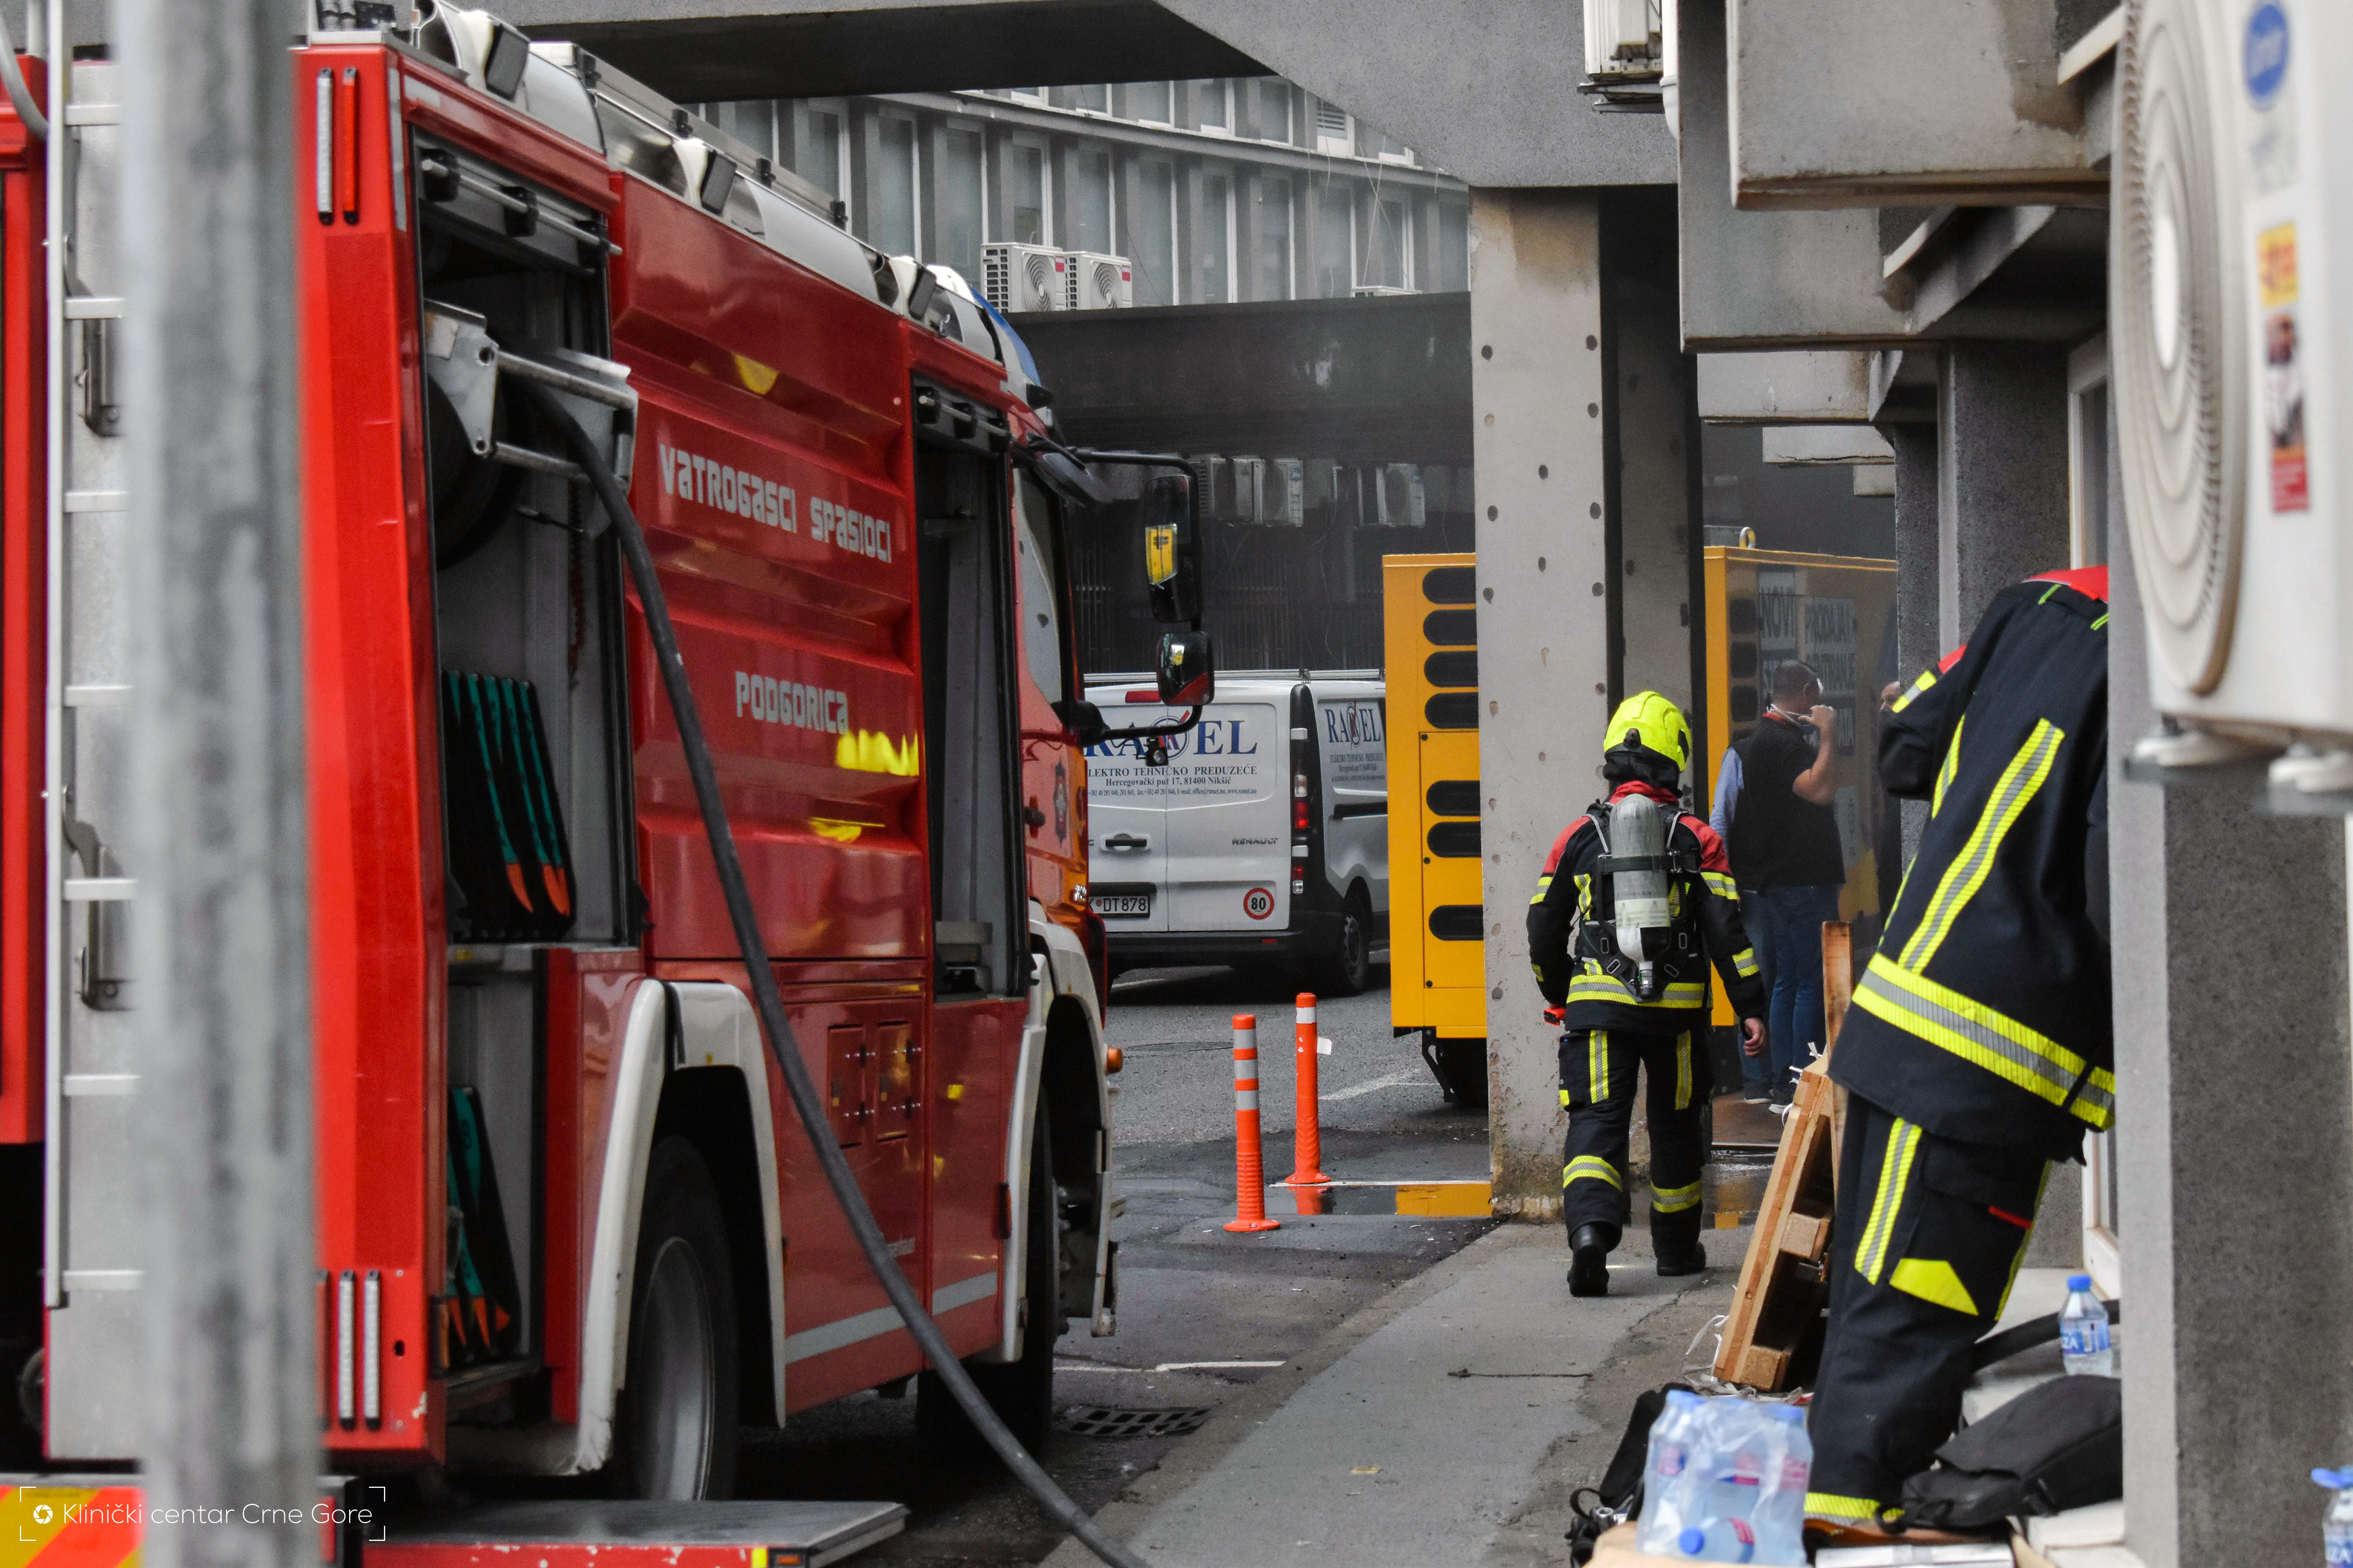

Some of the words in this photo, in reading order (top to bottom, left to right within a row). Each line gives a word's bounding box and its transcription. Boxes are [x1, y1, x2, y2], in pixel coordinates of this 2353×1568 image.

[1089, 767, 1129, 777] LEKTRO
[1133, 765, 1188, 776] TEHNIČKO
[1195, 764, 1257, 775] PREDUZEĆE
[1106, 777, 1154, 787] Hercegovački
[1157, 778, 1169, 787] put
[1172, 777, 1182, 786] 17,
[1208, 776, 1231, 785] Nikšić
[1251, 897, 1266, 911] 80
